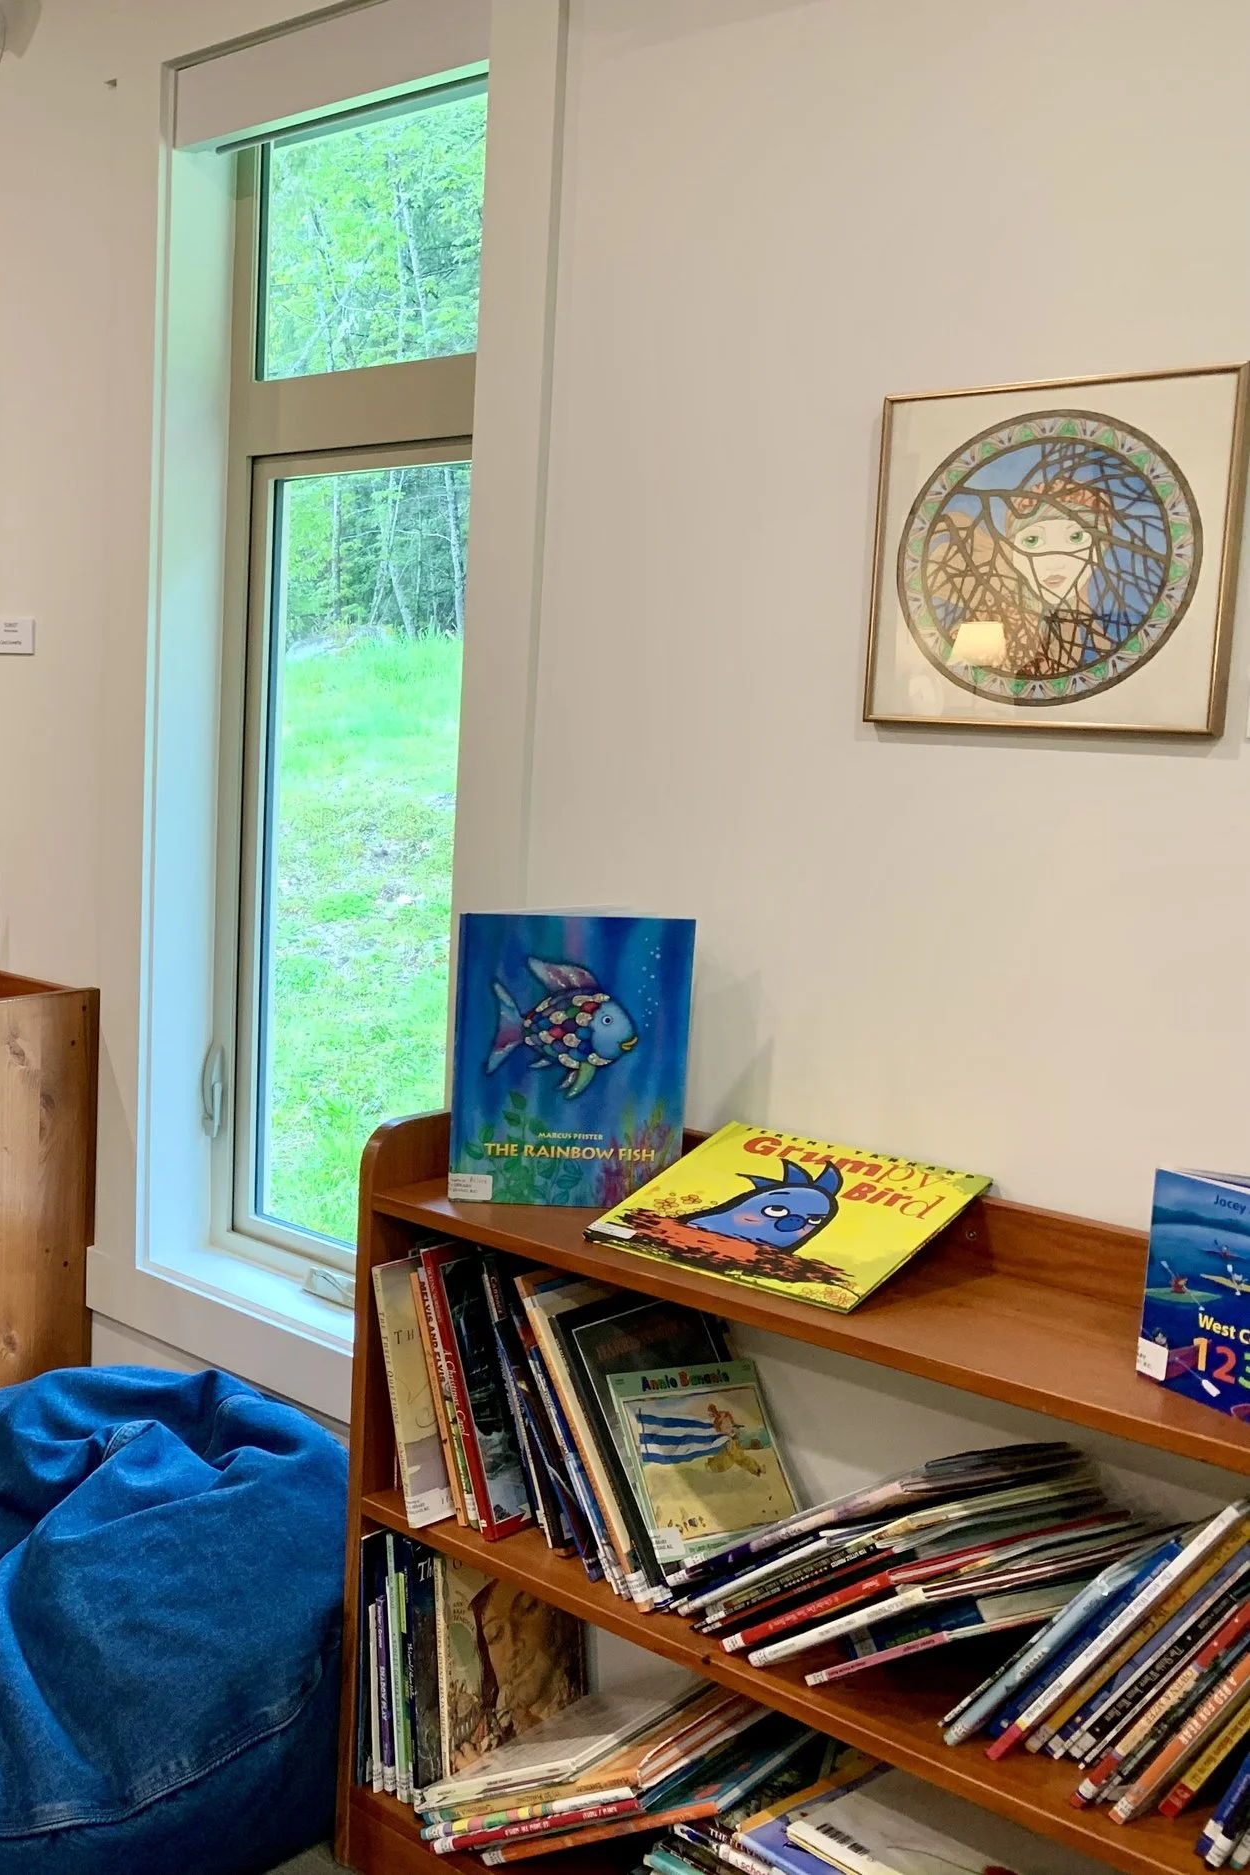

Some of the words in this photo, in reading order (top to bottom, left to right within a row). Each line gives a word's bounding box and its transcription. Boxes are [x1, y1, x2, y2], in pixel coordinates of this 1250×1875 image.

[538, 1132, 572, 1140] MARCUS
[573, 1132, 603, 1140] PFISTER
[484, 1142, 519, 1157] THE
[523, 1144, 614, 1160] RAINBOW
[618, 1148, 655, 1162] FISH
[743, 1136, 952, 1192] Grumpy
[840, 1182, 947, 1220] Bird
[1214, 1194, 1246, 1215] Jocey
[394, 1329, 415, 1345] TH
[420, 1281, 434, 1322] MELVIS
[429, 1326, 439, 1350] AND
[436, 1352, 446, 1382] ELVIS
[1198, 1313, 1236, 1339] West
[382, 1336, 391, 1366] THREE
[387, 1370, 399, 1425] QUESTIONS
[641, 1373, 678, 1391] Annie
[445, 1360, 461, 1407] Christmas
[456, 1410, 470, 1437] Carol
[417, 1557, 434, 1582] Th
[378, 1665, 388, 1700] SHADOW
[1228, 1676, 1239, 1687] A
[380, 1701, 388, 1720] PLAY
[1196, 1701, 1216, 1722] FOR
